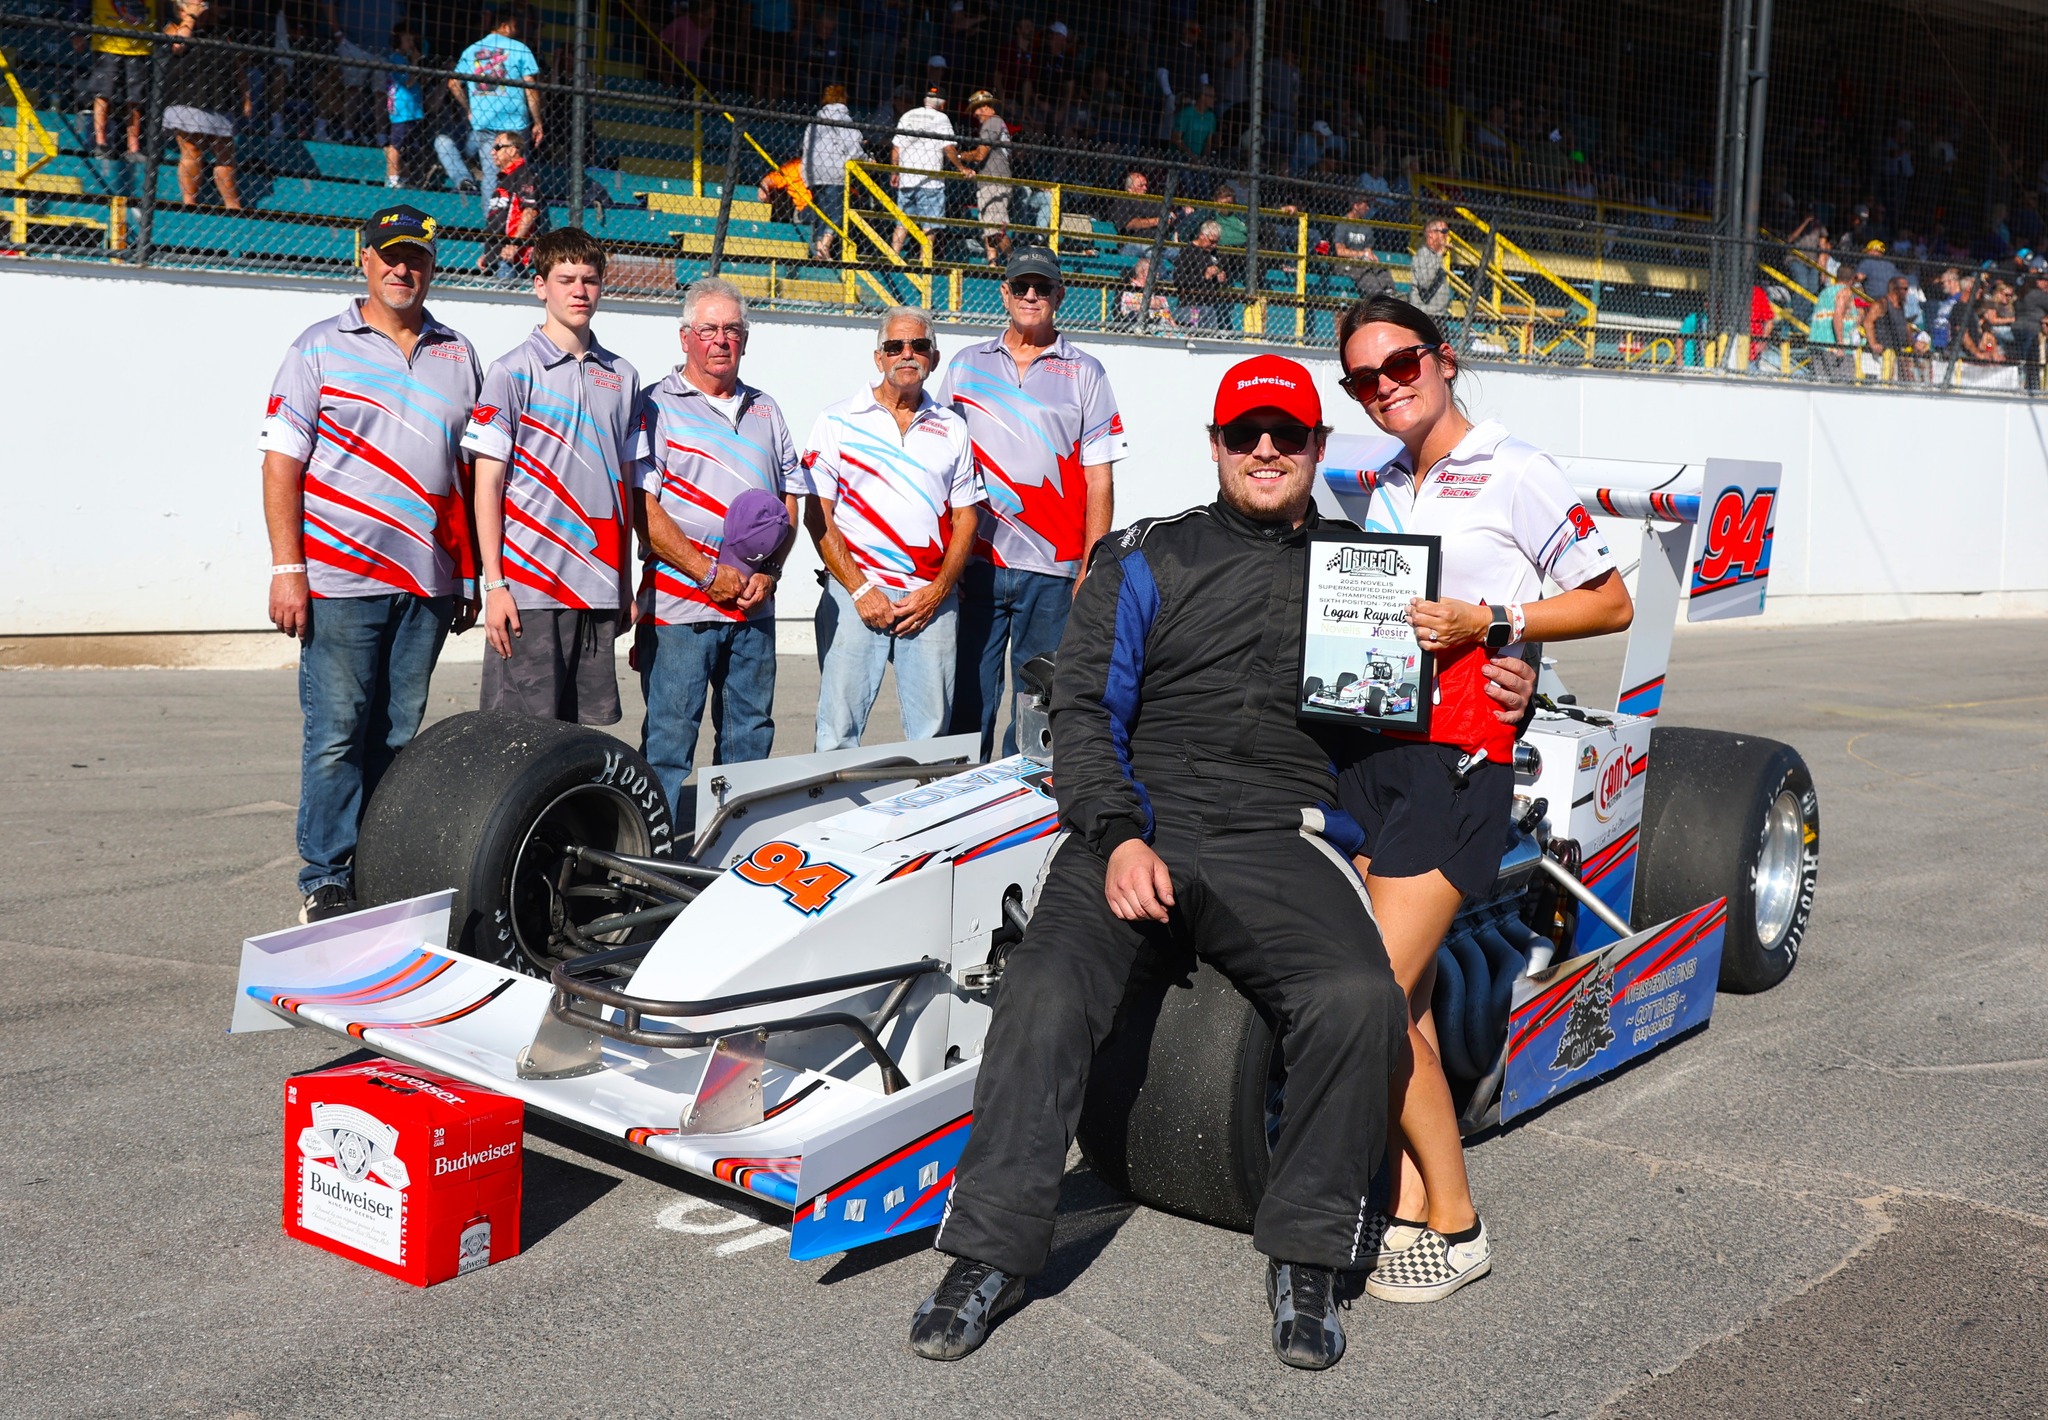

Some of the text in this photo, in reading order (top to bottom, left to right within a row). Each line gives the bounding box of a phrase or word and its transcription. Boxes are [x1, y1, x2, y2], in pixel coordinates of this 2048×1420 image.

[1237, 375, 1297, 391] Budweiser
[471, 401, 502, 426] 4
[1435, 470, 1491, 484] RAYVALS
[1437, 486, 1481, 498] RACING
[1698, 486, 1776, 583] 94
[1340, 547, 1398, 576] OSWEGO
[1318, 584, 1417, 595] SUPERMODIFIED DRIVER'S
[1336, 592, 1396, 601] CHAMPIONSHIP
[1342, 599, 1378, 607] POSITION
[1323, 604, 1359, 623] Logan
[1320, 623, 1361, 635] Novelis
[731, 841, 857, 918] 94
[288, 1086, 297, 1095] 30
[433, 1128, 445, 1138] 30
[433, 1141, 516, 1176] Budweiser
[310, 1171, 393, 1220] Budweiser
